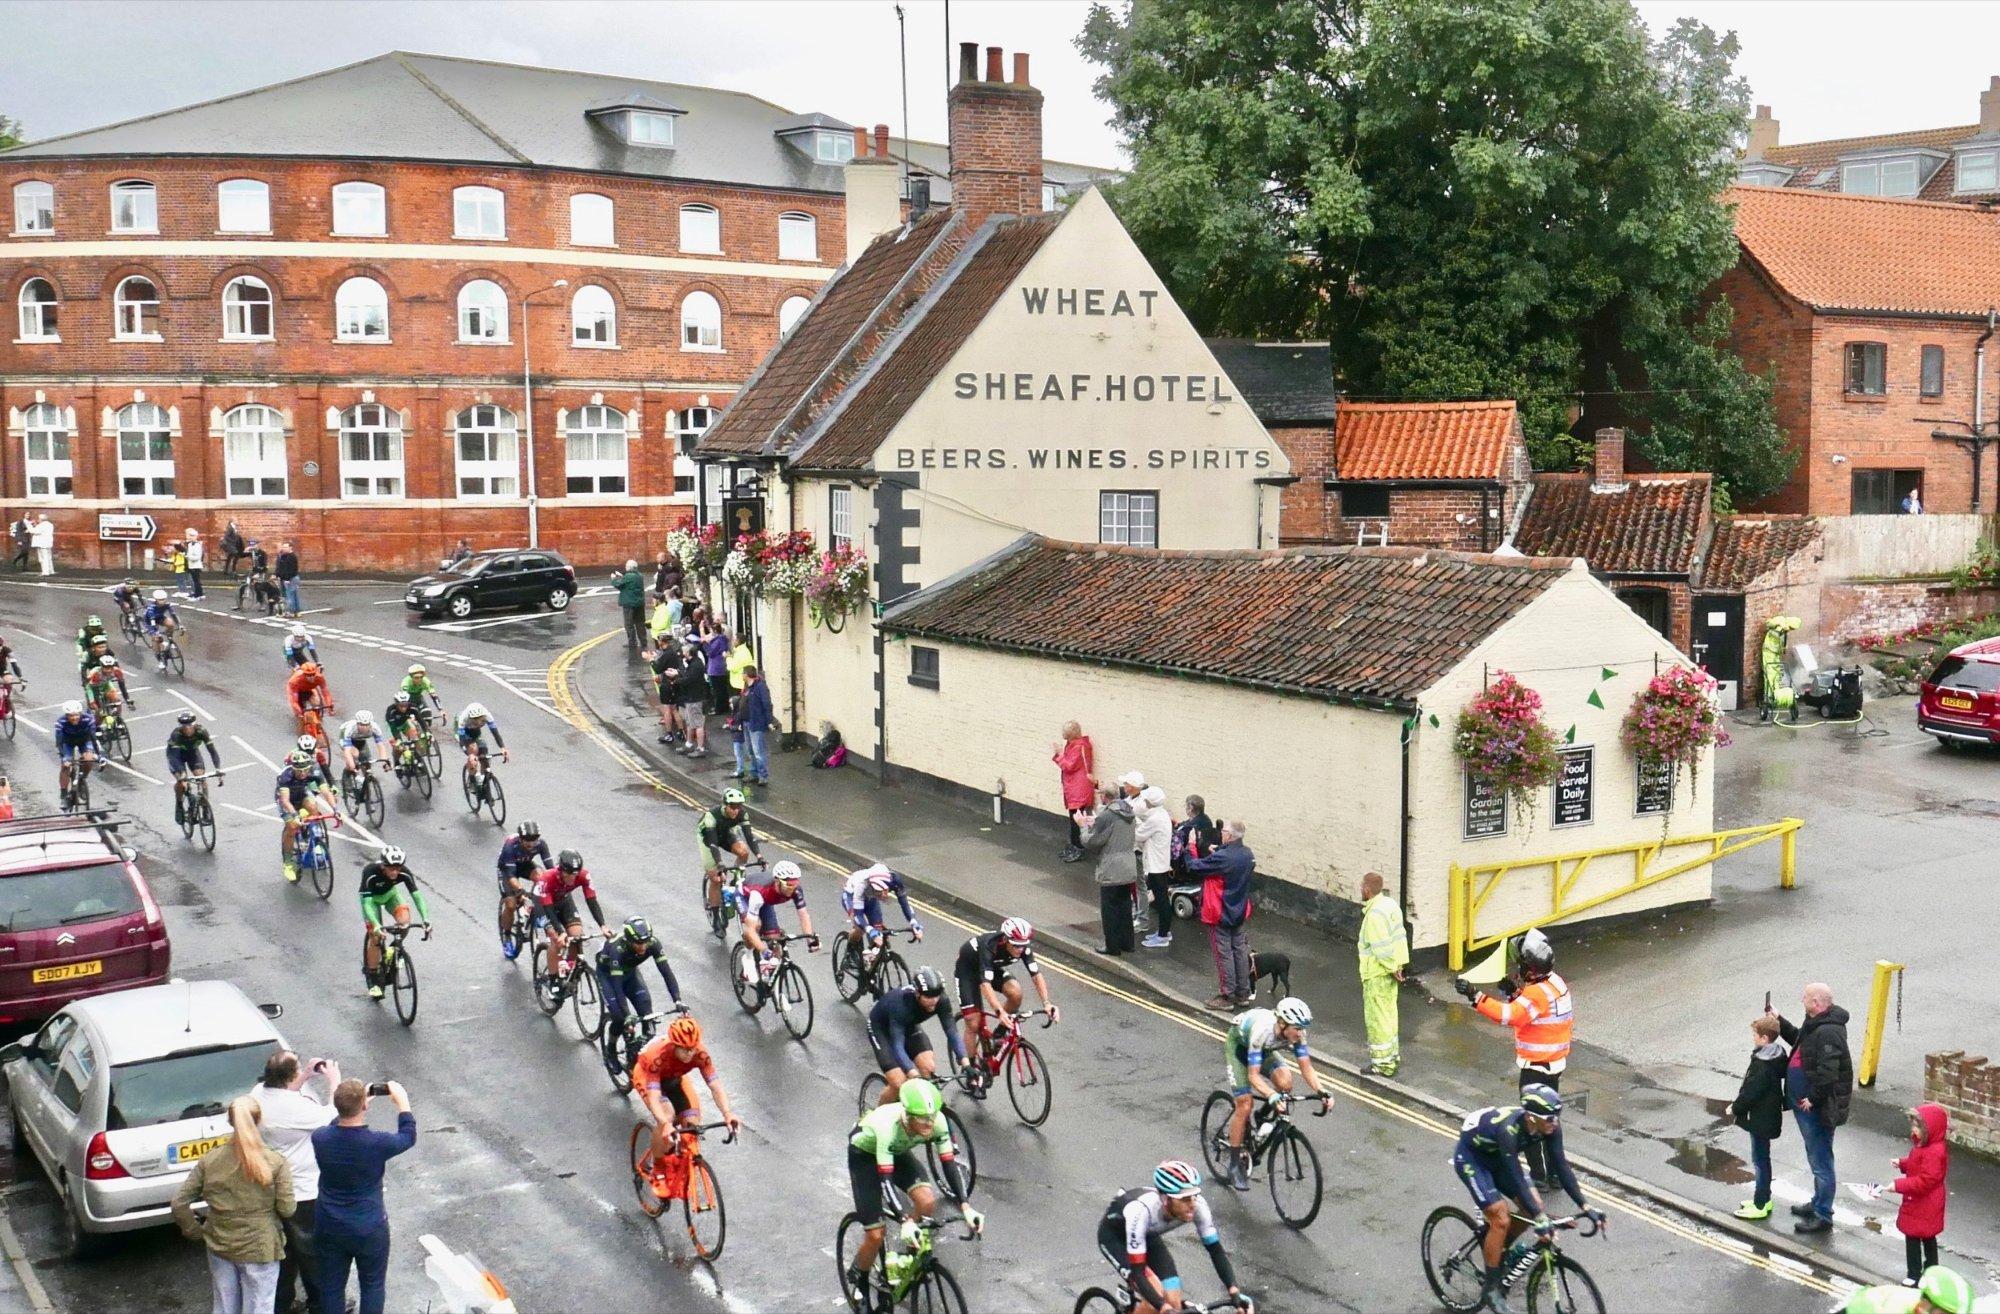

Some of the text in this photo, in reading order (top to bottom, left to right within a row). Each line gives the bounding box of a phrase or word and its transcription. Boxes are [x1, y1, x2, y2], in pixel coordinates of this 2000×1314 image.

[1022, 287, 1159, 317] WHEAT
[1147, 449, 1271, 470] SPIRITS
[1562, 786, 1586, 801] Daily
[38, 962, 97, 981] SD07 AJY
